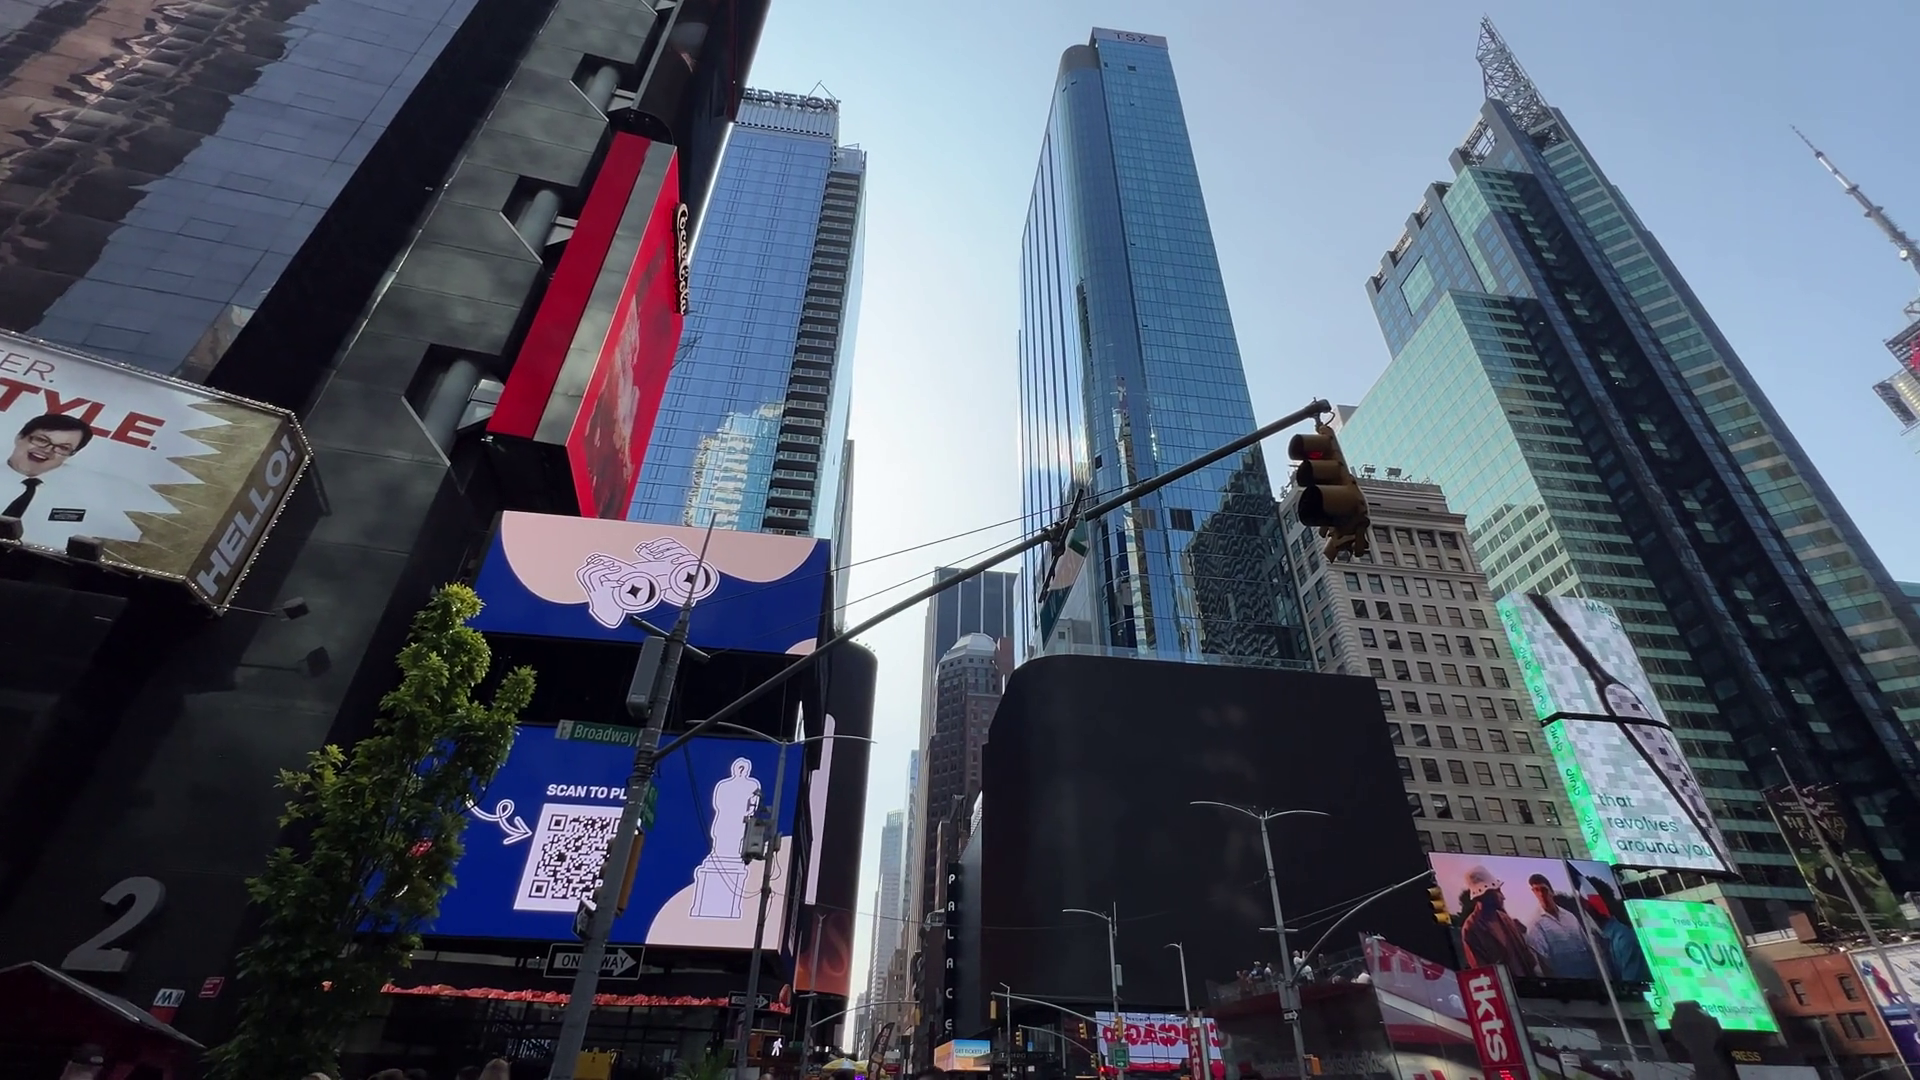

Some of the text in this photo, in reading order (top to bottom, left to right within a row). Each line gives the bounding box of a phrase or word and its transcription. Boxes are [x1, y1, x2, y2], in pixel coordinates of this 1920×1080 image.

[1114, 32, 1148, 44] TSX
[743, 87, 841, 113] EDITION
[0, 350, 55, 383] ER.
[196, 434, 296, 597] HELLO!
[574, 724, 637, 747] Broadway
[546, 784, 628, 800] SCAN TO PL
[1600, 793, 1632, 808] that
[1607, 815, 1679, 833] revolves
[1616, 838, 1683, 855] around
[61, 876, 166, 972] 2
[561, 954, 629, 969] ON WAY
[945, 873, 956, 1030] PALACE
[1684, 941, 1743, 973] quip
[1468, 974, 1508, 1063] tkts
